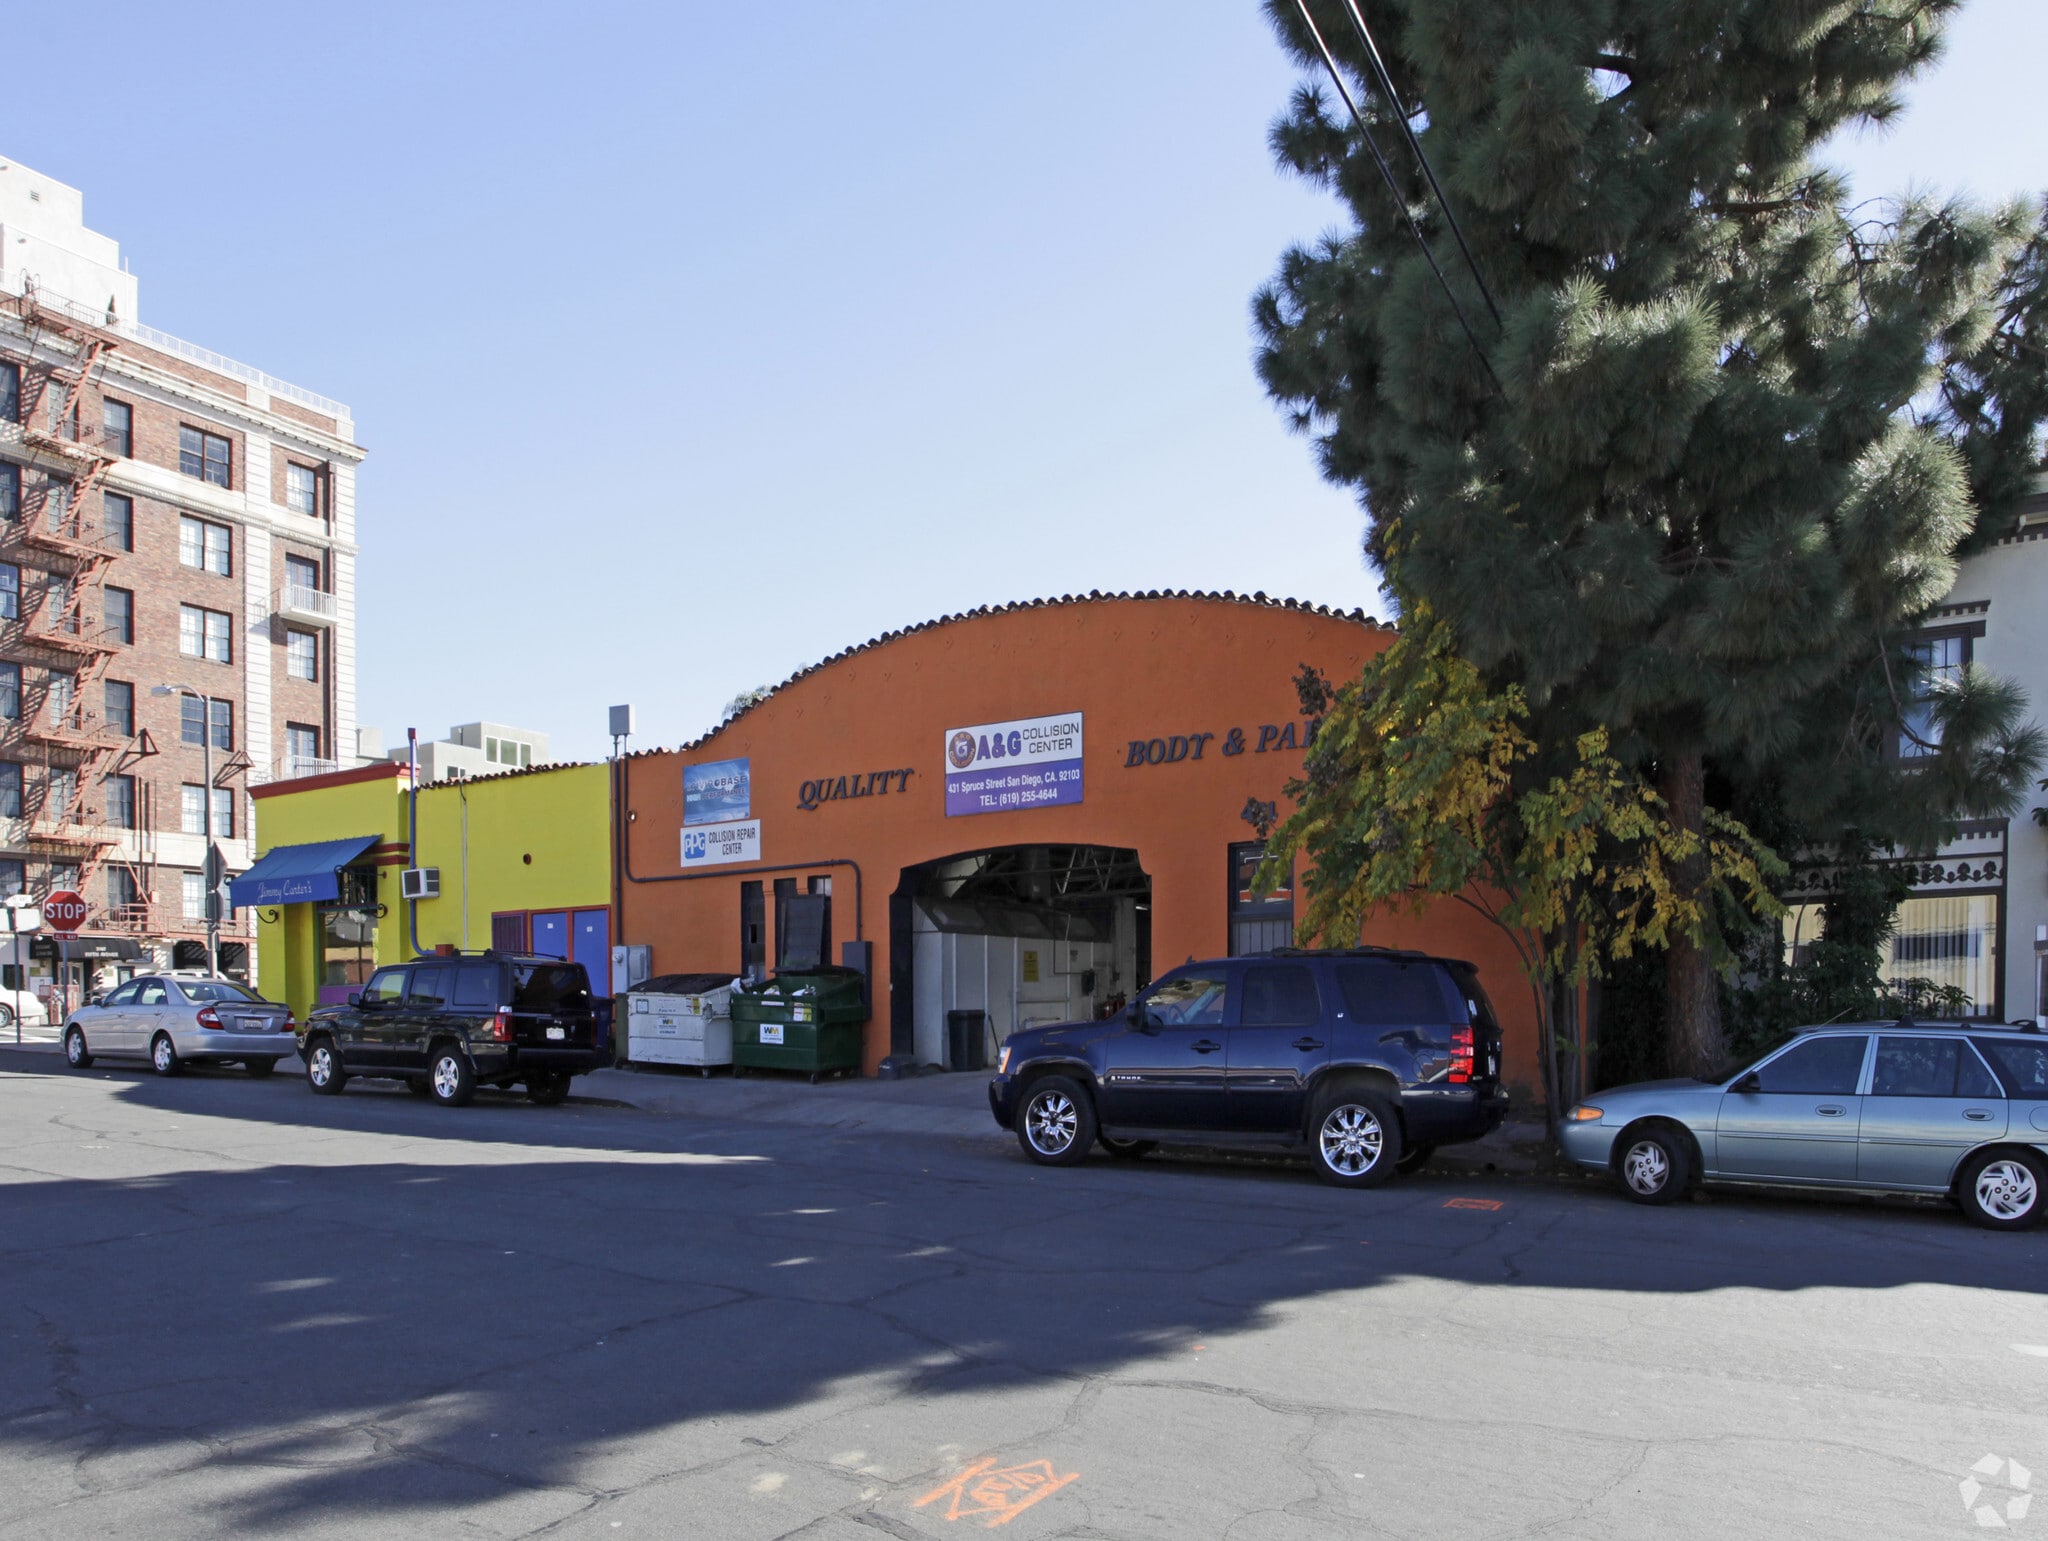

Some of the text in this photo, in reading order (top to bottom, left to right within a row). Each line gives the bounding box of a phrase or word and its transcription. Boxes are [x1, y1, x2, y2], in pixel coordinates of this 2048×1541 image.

[1023, 723, 1079, 740] COLLISION
[976, 731, 1021, 760] A&G
[1029, 738, 1073, 754] CENTER
[1124, 732, 1214, 768] BODY
[1222, 727, 1246, 757] &
[797, 768, 915, 811] QUALITY
[948, 769, 1080, 794] 431 Spruce Street San Diego, CA. 92103
[979, 788, 1058, 807] TEL: (619) 255-4644
[685, 833, 705, 855] PPG
[708, 827, 756, 844] COLLISION REPAIR
[722, 842, 743, 855] CENTER
[257, 880, 313, 904] Jimmy Carter's
[46, 903, 85, 919] STOP
